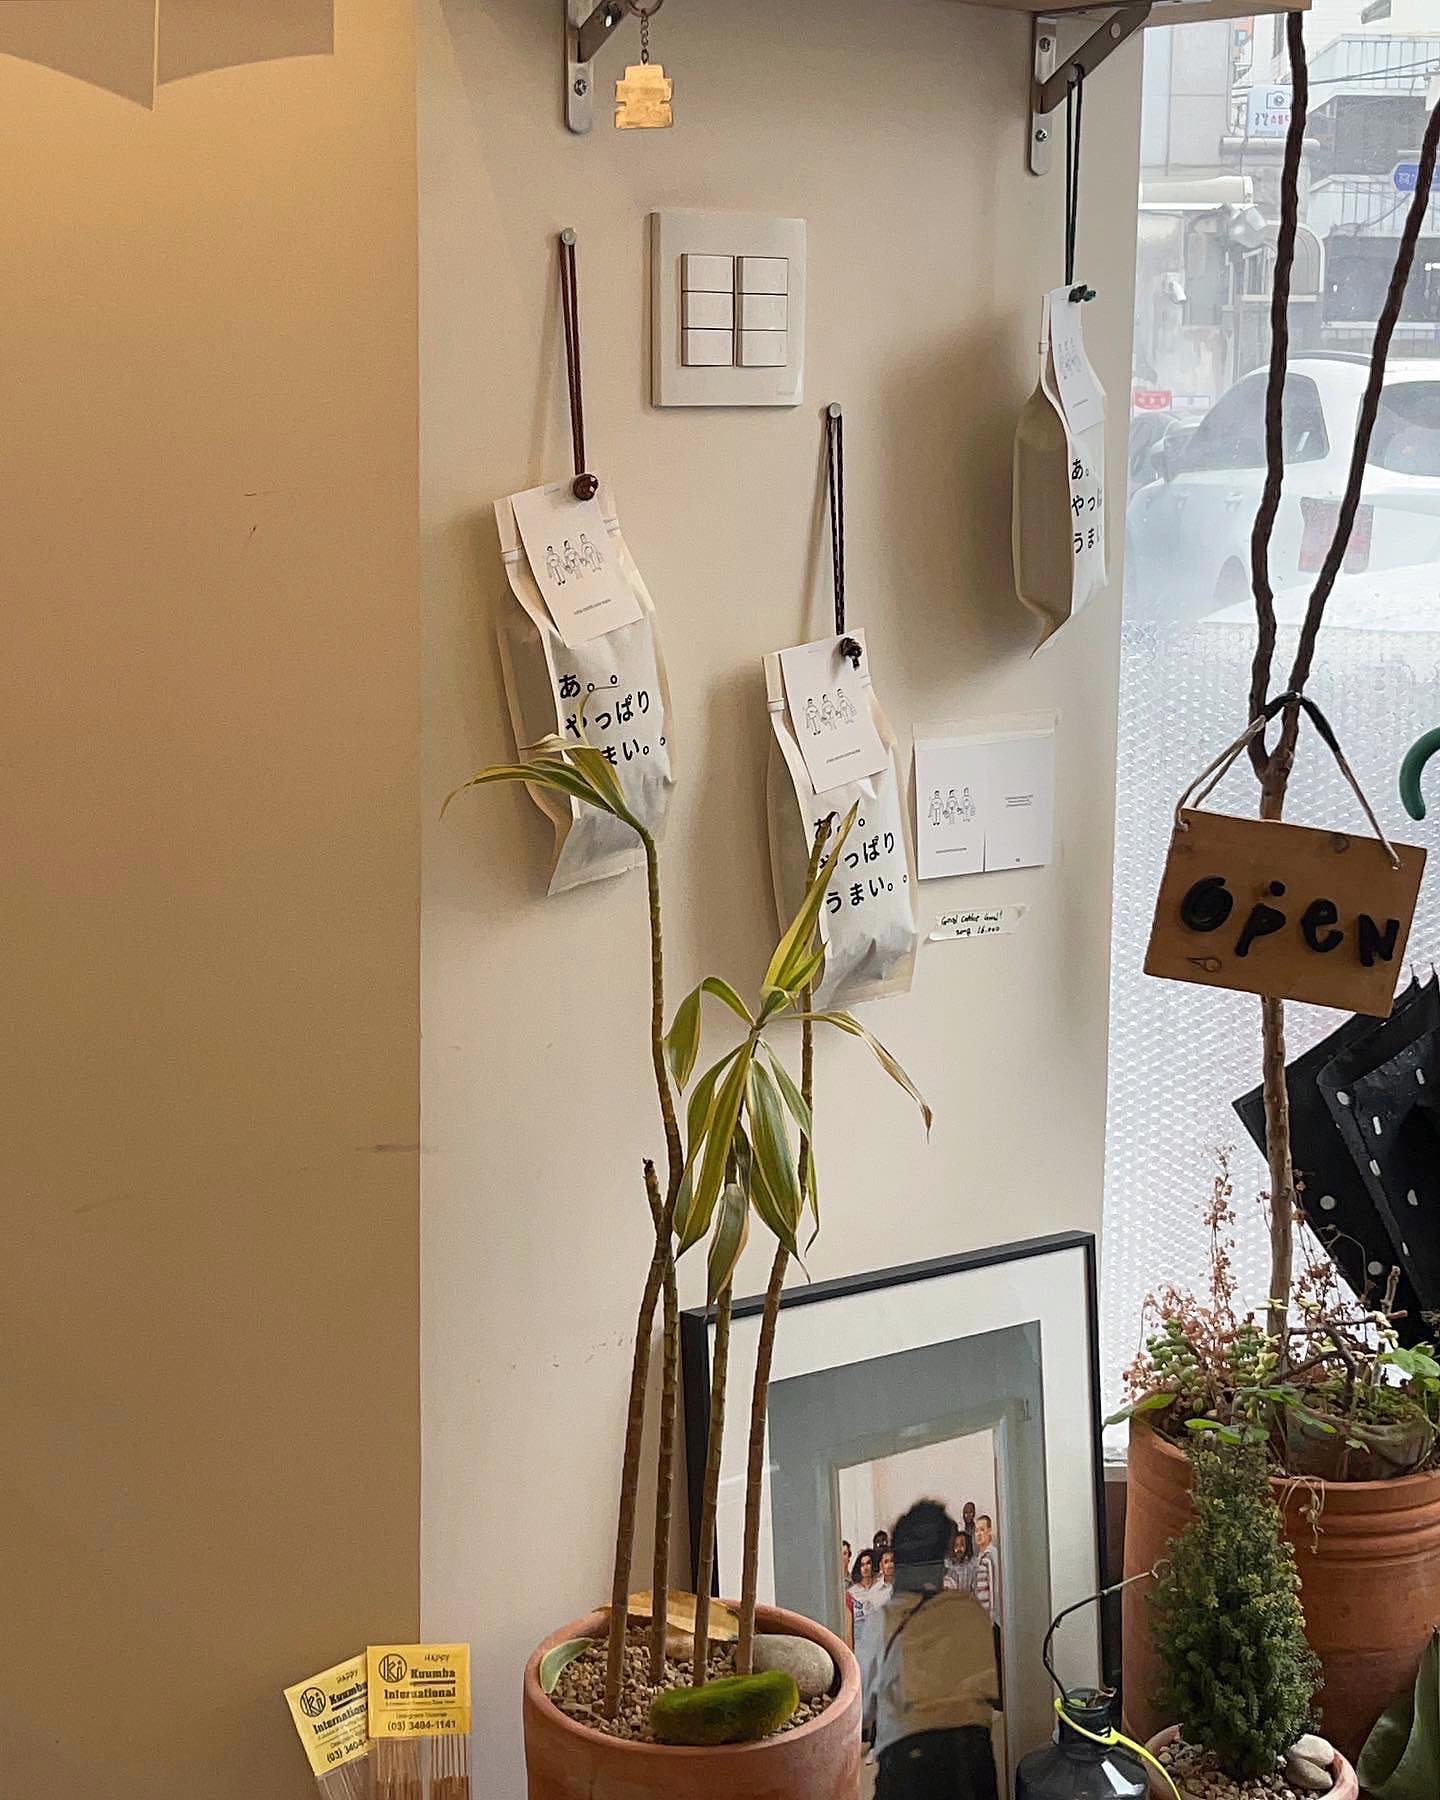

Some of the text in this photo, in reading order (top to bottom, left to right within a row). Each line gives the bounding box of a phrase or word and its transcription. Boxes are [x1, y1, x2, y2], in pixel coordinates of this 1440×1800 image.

[565, 690, 650, 739] やっぱり
[601, 736, 666, 766] まい。。
[410, 1667, 457, 1680] Kuumba
[383, 1687, 457, 1701] International
[312, 1700, 368, 1735] Internation
[387, 1720, 407, 1733] (03)
